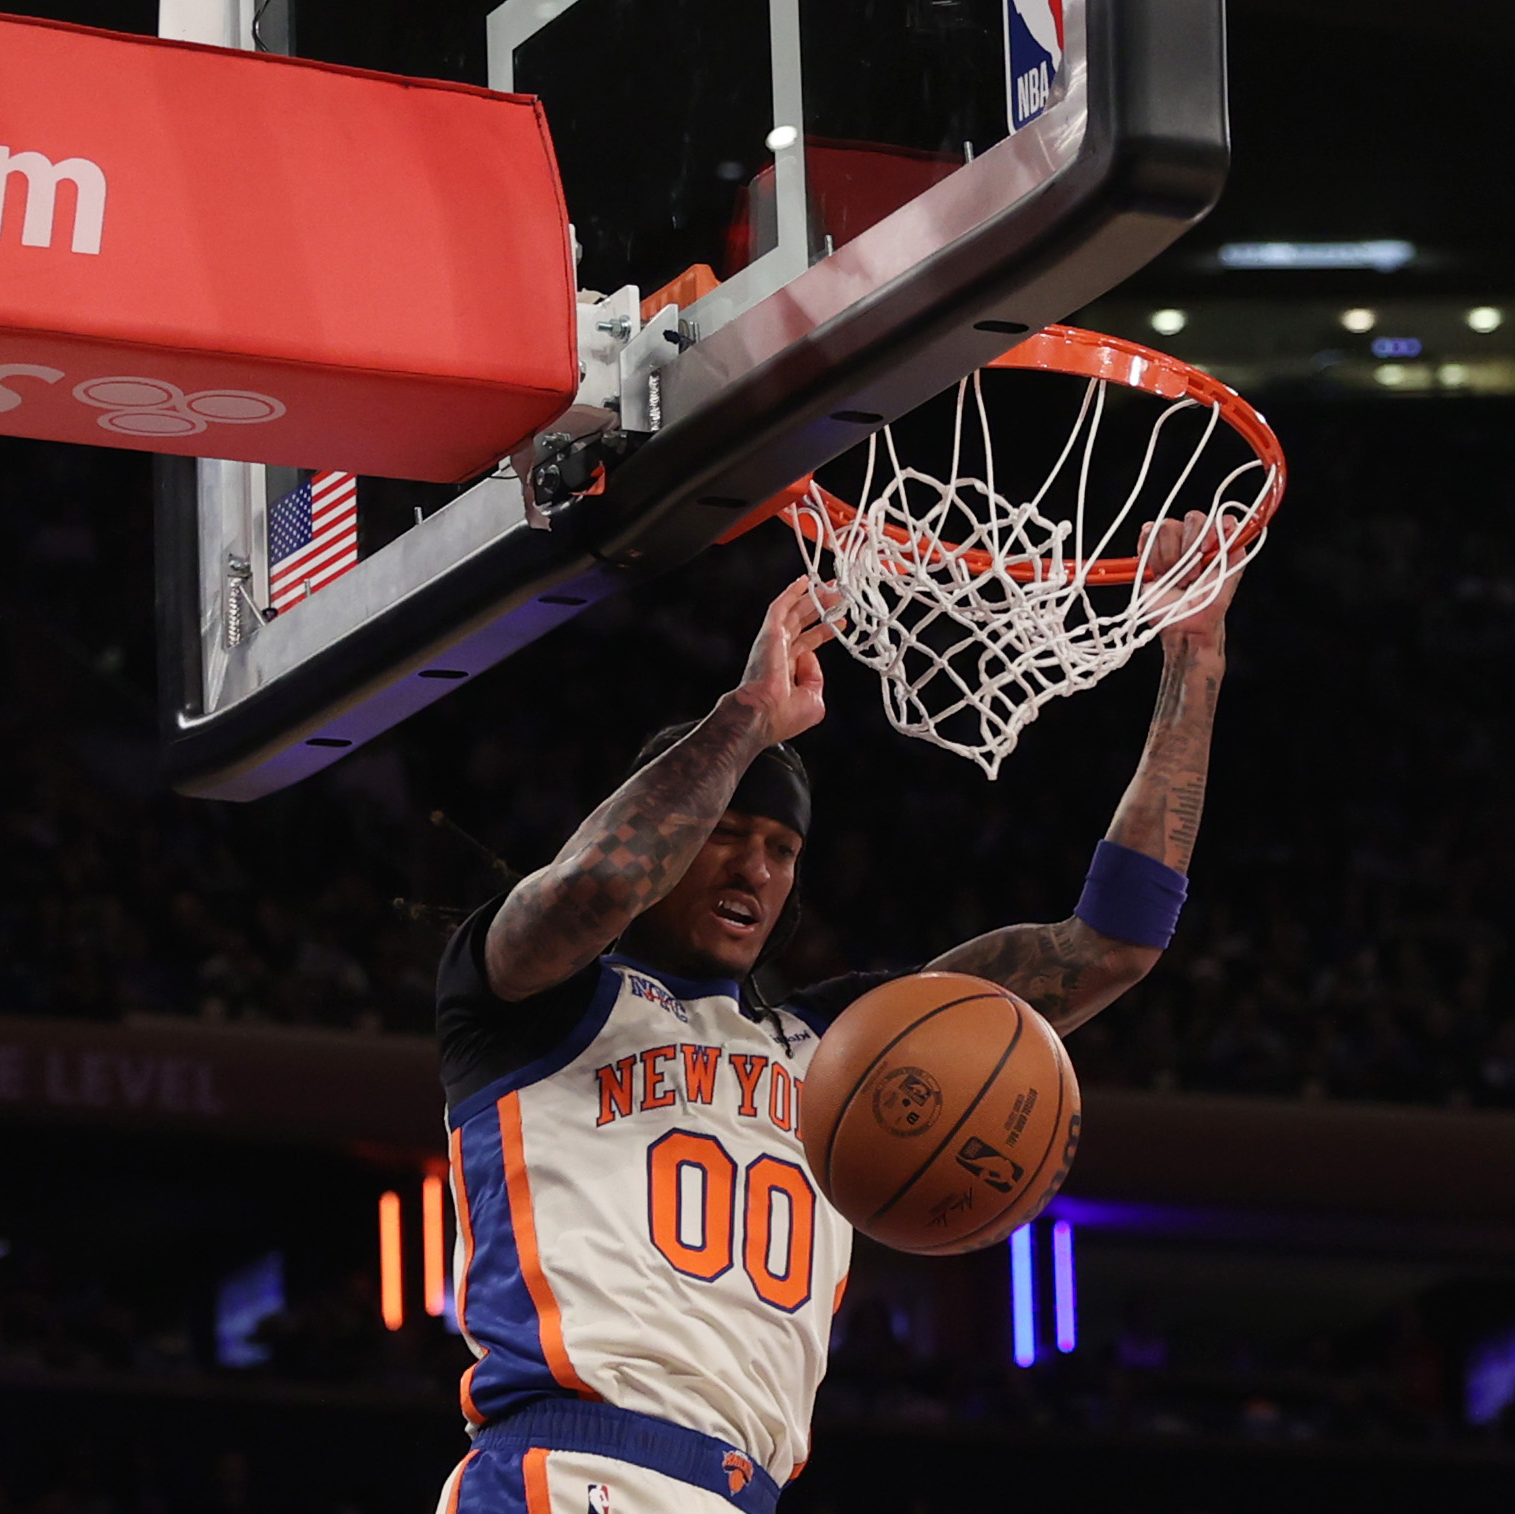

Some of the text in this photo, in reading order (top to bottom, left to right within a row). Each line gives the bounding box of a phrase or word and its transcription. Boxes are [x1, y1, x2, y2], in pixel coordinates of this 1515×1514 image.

[1017, 60, 1049, 122] NBA
[44, 1046, 224, 1116] LEVEL
[596, 1043, 722, 1128] NEW
[728, 1053, 805, 1142] YO
[647, 1127, 816, 1314] 00
